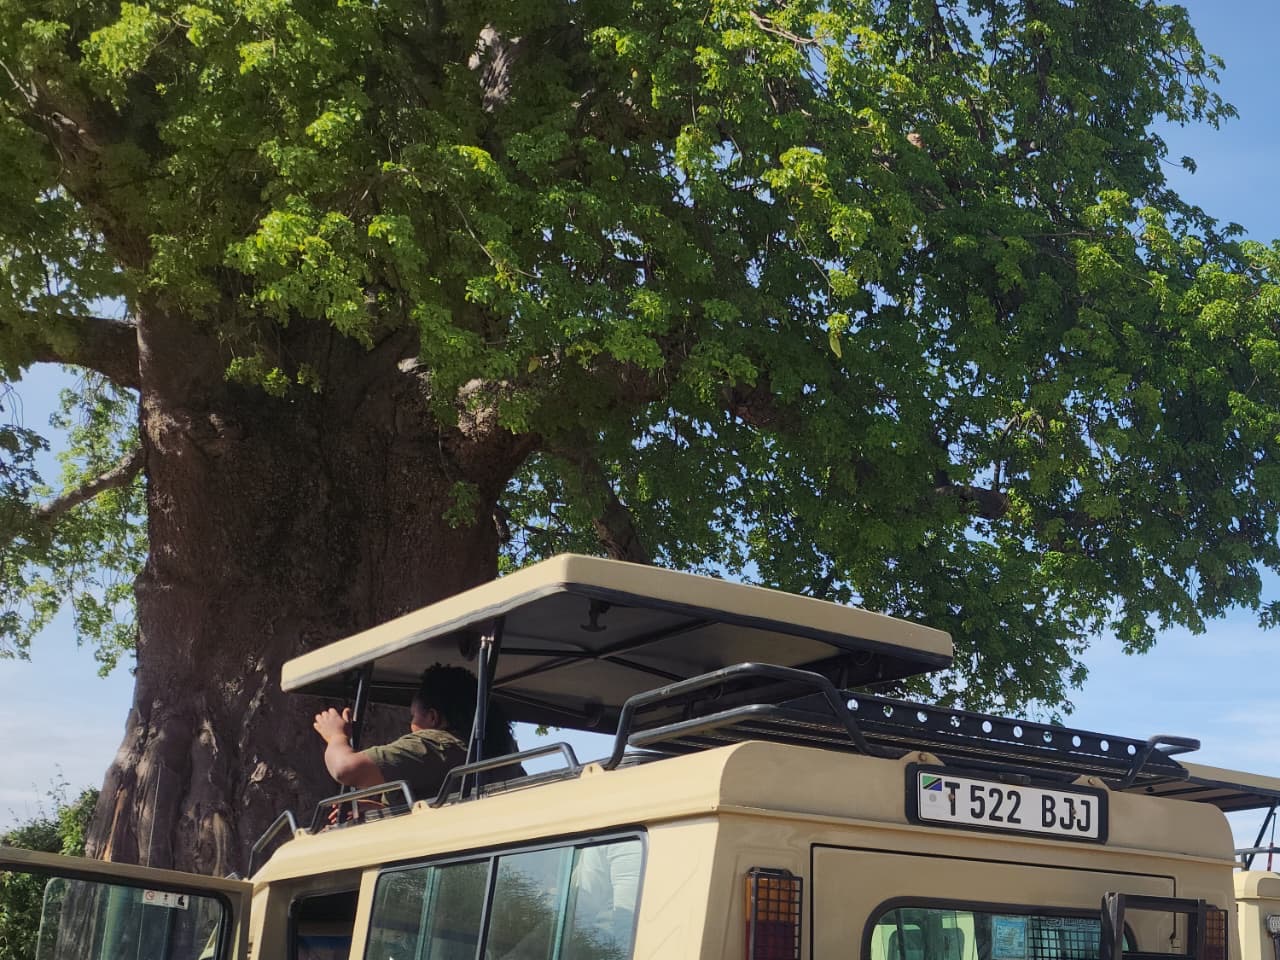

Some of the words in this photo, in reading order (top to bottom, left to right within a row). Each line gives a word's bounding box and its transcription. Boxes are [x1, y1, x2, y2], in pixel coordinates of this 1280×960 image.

[944, 781, 961, 817] T
[970, 785, 1022, 824] 522
[1041, 794, 1092, 832] BJJ
